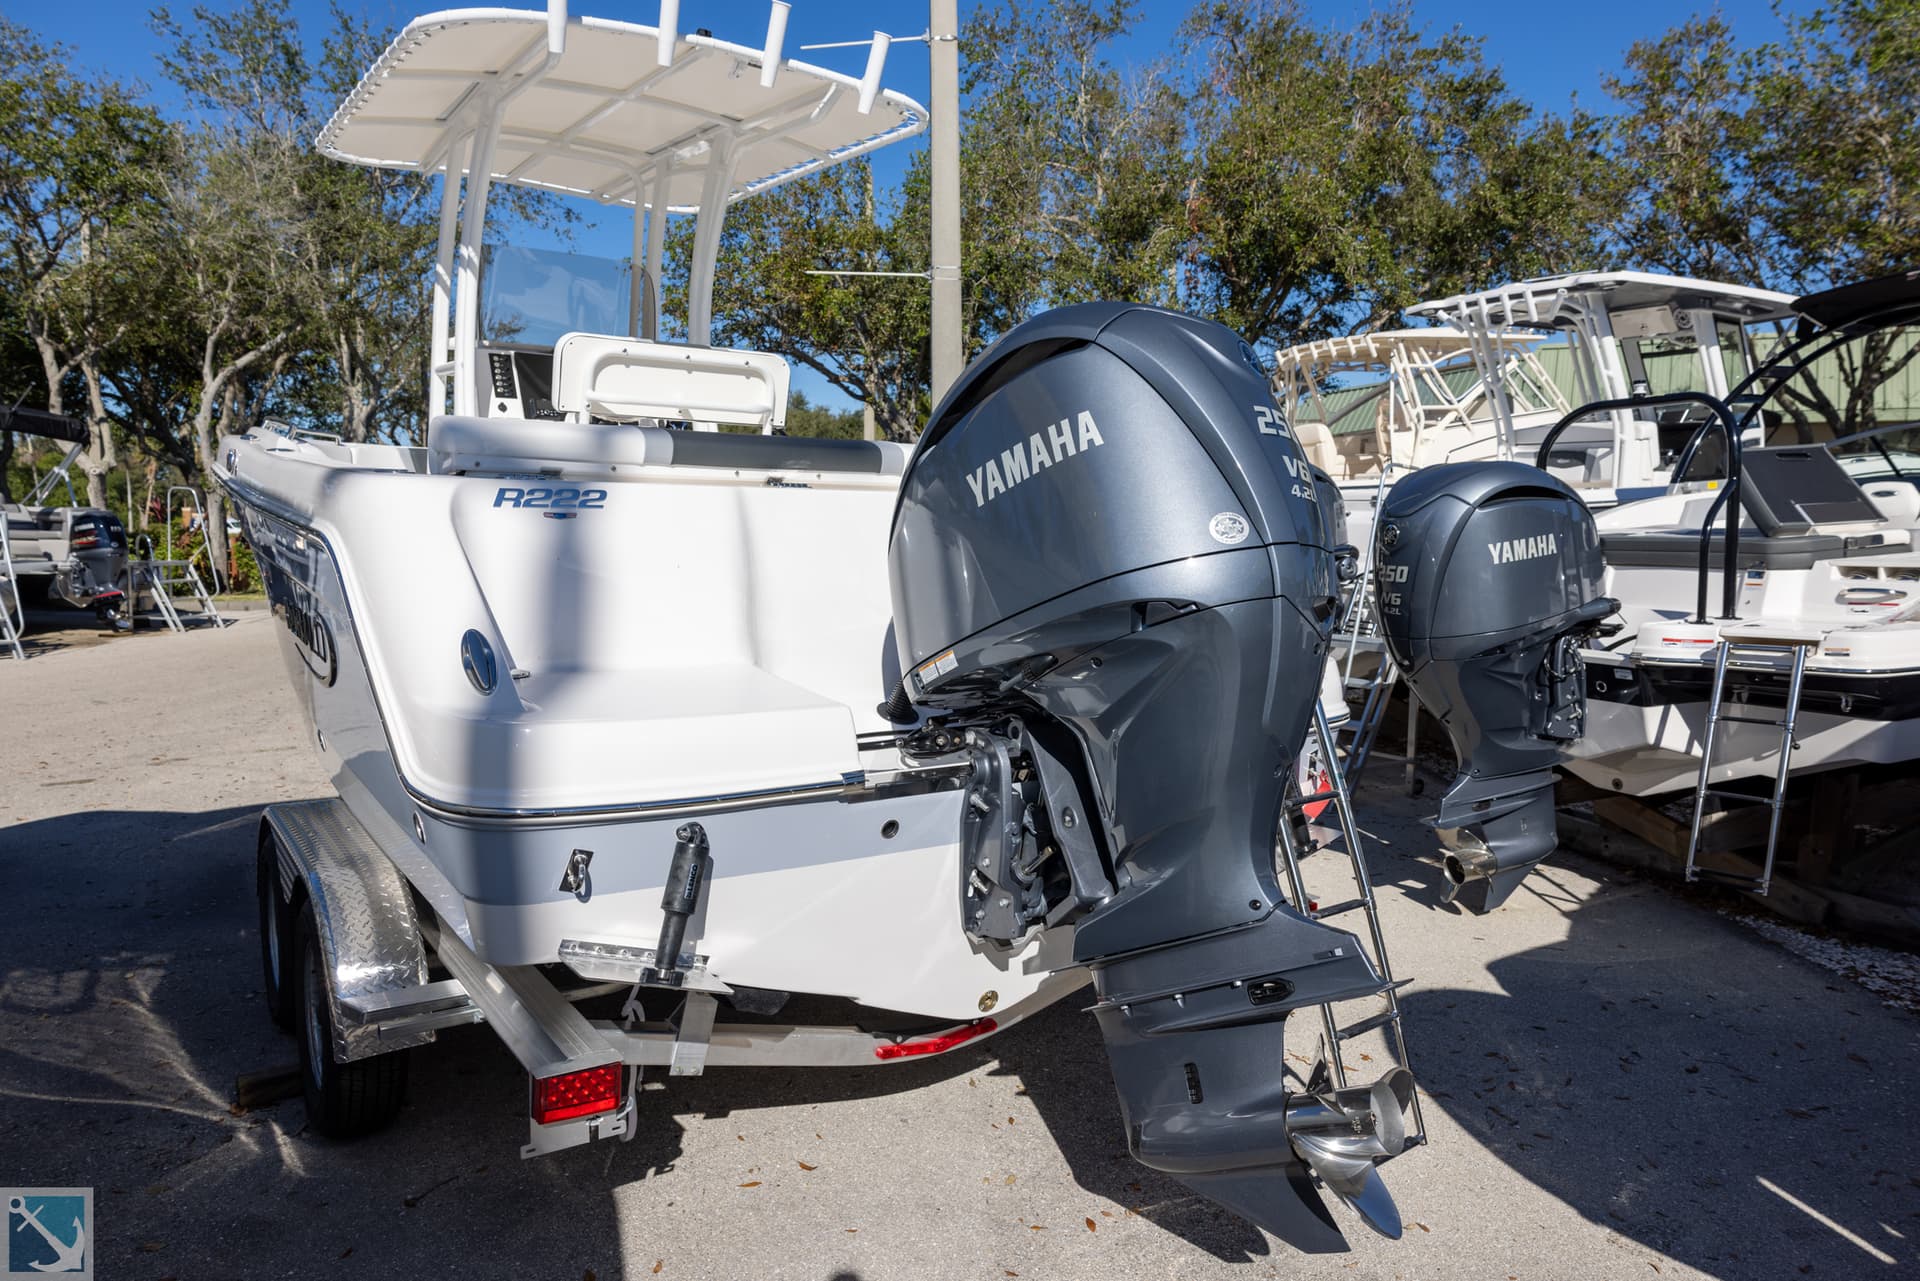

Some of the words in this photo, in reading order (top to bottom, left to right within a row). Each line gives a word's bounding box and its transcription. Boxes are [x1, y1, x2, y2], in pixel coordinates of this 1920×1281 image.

[1253, 405, 1292, 439] 25
[965, 410, 1104, 508] YAMAHA
[1282, 455, 1312, 483] V6
[493, 487, 608, 508] R222
[1291, 484, 1317, 503] 4.2L
[1488, 533, 1557, 564] YAMAHA
[1378, 565, 1409, 583] 250
